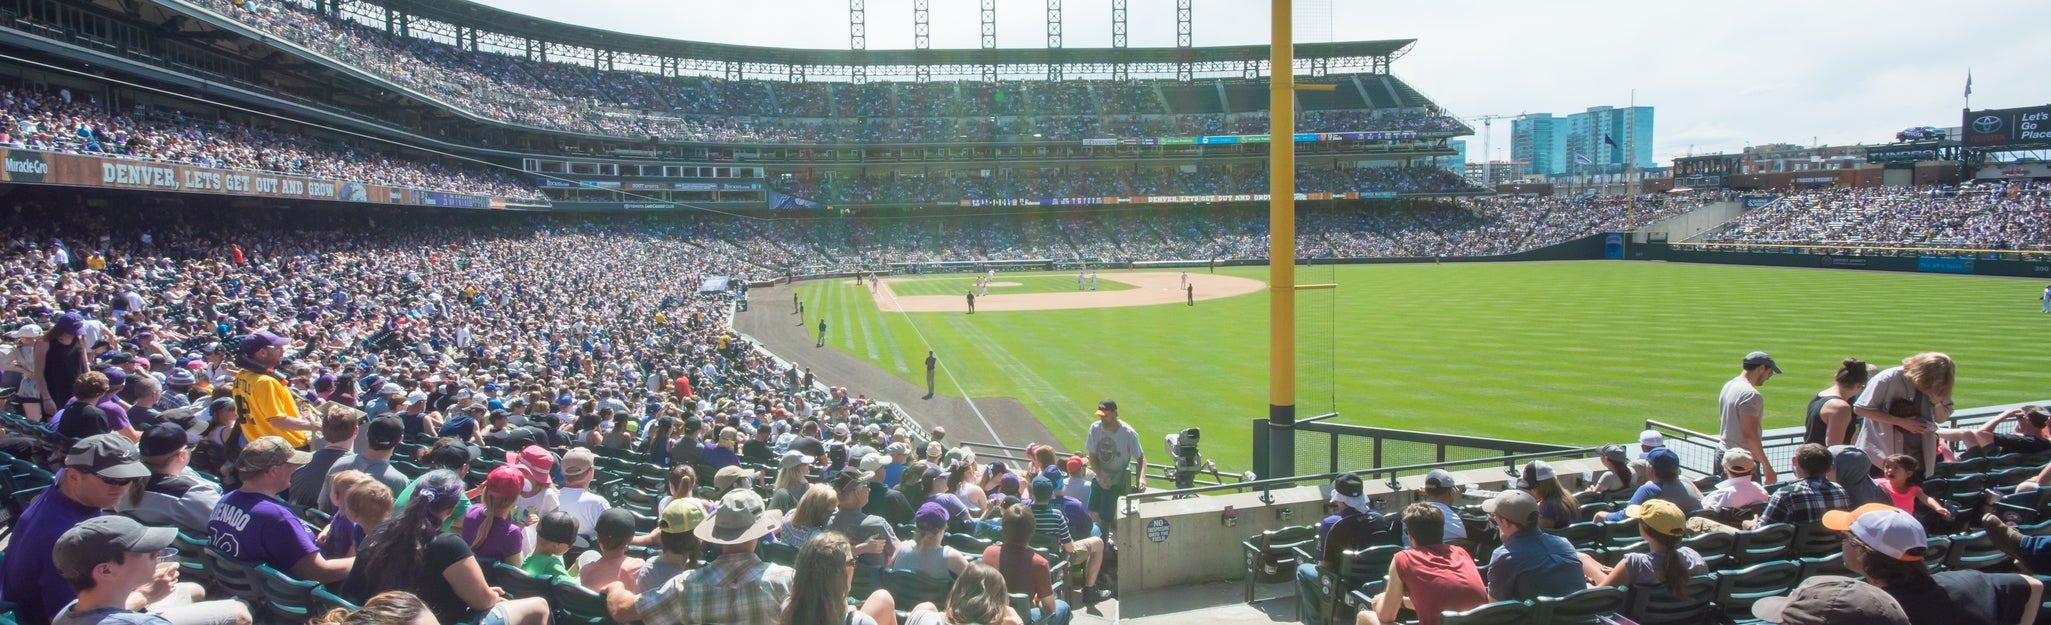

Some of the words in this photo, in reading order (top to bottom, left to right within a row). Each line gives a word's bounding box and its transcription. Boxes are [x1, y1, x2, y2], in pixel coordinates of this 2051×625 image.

[2022, 112, 2049, 122] Let's
[2021, 122, 2037, 130] Go
[5, 157, 48, 175] Miracle-Gro
[103, 163, 179, 189] DENVER,
[185, 170, 222, 190] LETS
[226, 174, 250, 192] GET
[256, 177, 278, 193] OUT
[282, 180, 303, 195] AND
[308, 182, 335, 197] GROW
[1153, 519, 1164, 527] NO
